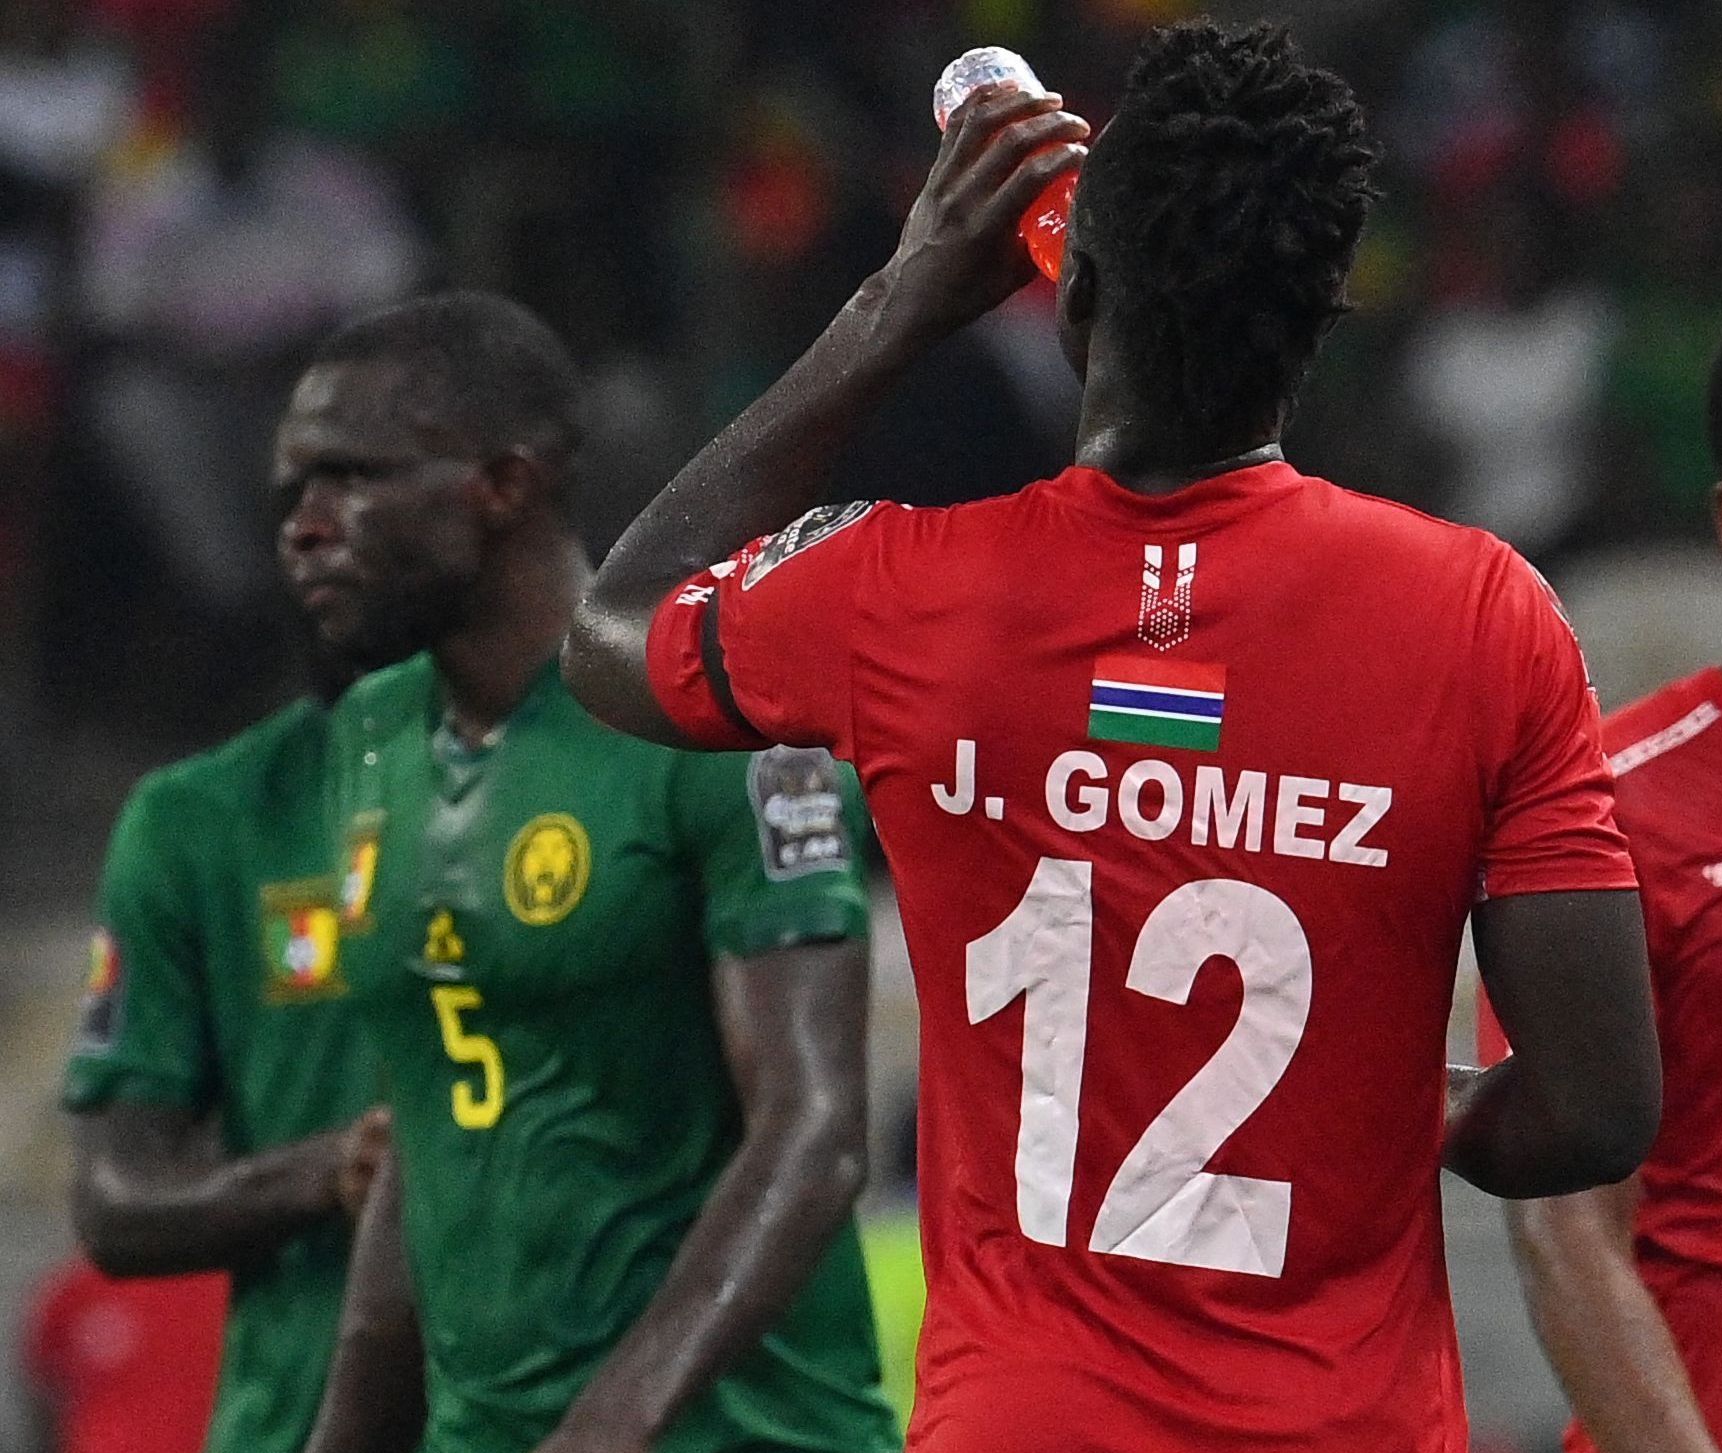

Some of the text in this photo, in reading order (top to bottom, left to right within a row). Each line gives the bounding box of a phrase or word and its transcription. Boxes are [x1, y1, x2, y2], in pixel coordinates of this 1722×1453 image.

[930, 738, 1004, 821] J.
[1044, 749, 1393, 868] GOMEZ
[431, 985, 504, 1130] 5
[965, 856, 1313, 1279] 12
